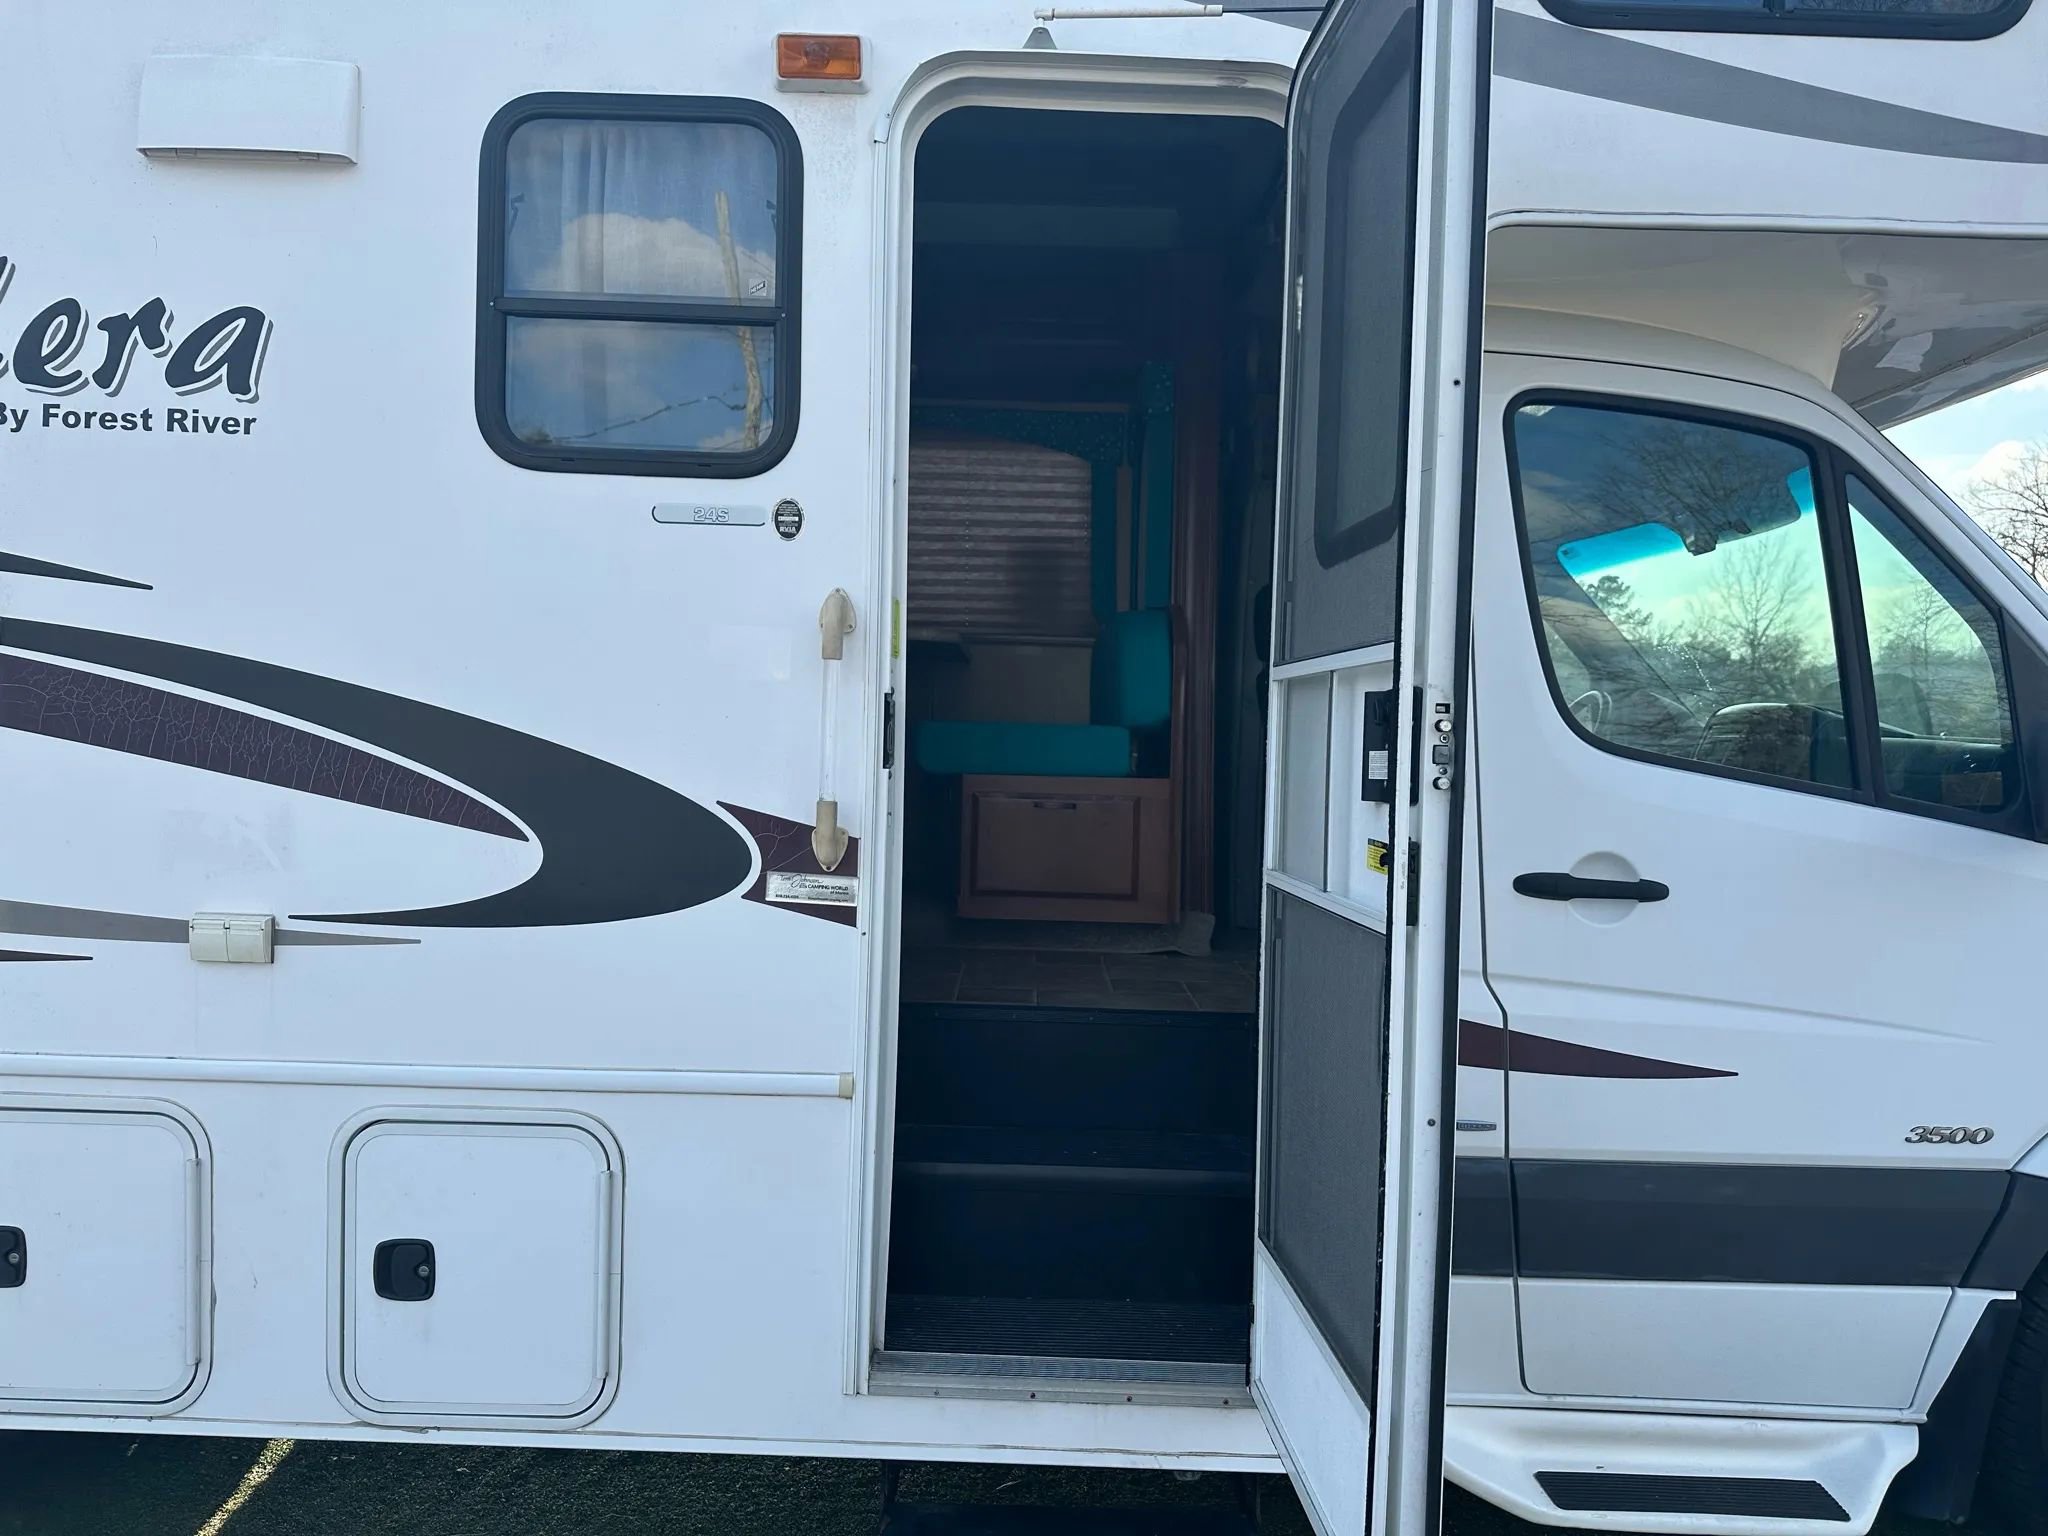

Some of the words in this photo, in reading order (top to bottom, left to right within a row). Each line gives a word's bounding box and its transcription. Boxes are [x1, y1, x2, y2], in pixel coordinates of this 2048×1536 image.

[42, 402, 153, 432] Forest
[166, 407, 257, 435] River
[693, 506, 729, 523] 24S
[1904, 1125, 1995, 1145] 3500
